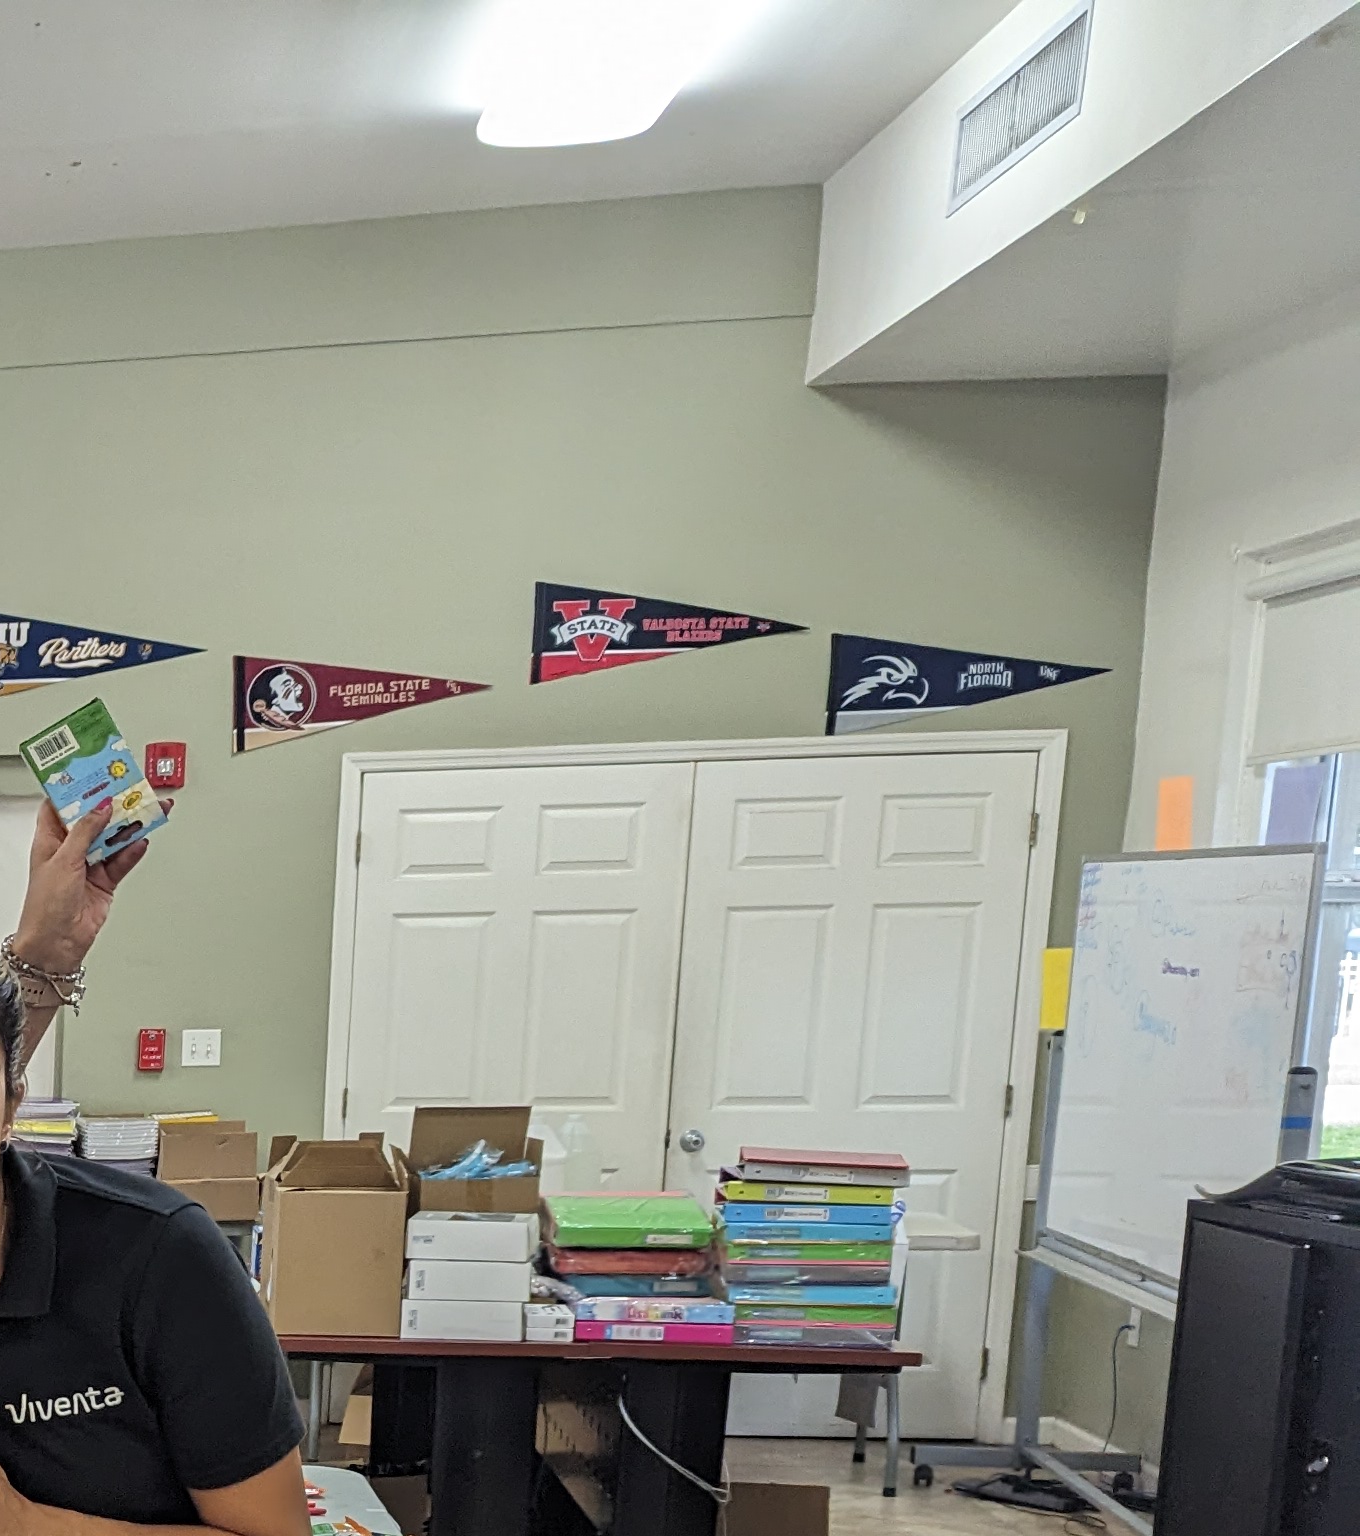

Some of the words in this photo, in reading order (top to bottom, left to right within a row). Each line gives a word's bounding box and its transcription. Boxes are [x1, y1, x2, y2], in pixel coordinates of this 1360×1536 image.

[566, 618, 618, 635] STATE
[709, 616, 750, 629] STATE
[37, 635, 128, 669] Panthers
[969, 662, 1005, 675] NORTH
[1039, 665, 1058, 681] UNF
[329, 682, 385, 697] FLORIDA
[389, 679, 430, 693] STATE
[958, 670, 1013, 691] FLORIDA
[342, 691, 417, 708] SEMINOLES
[4, 1386, 124, 1424] Viventa
